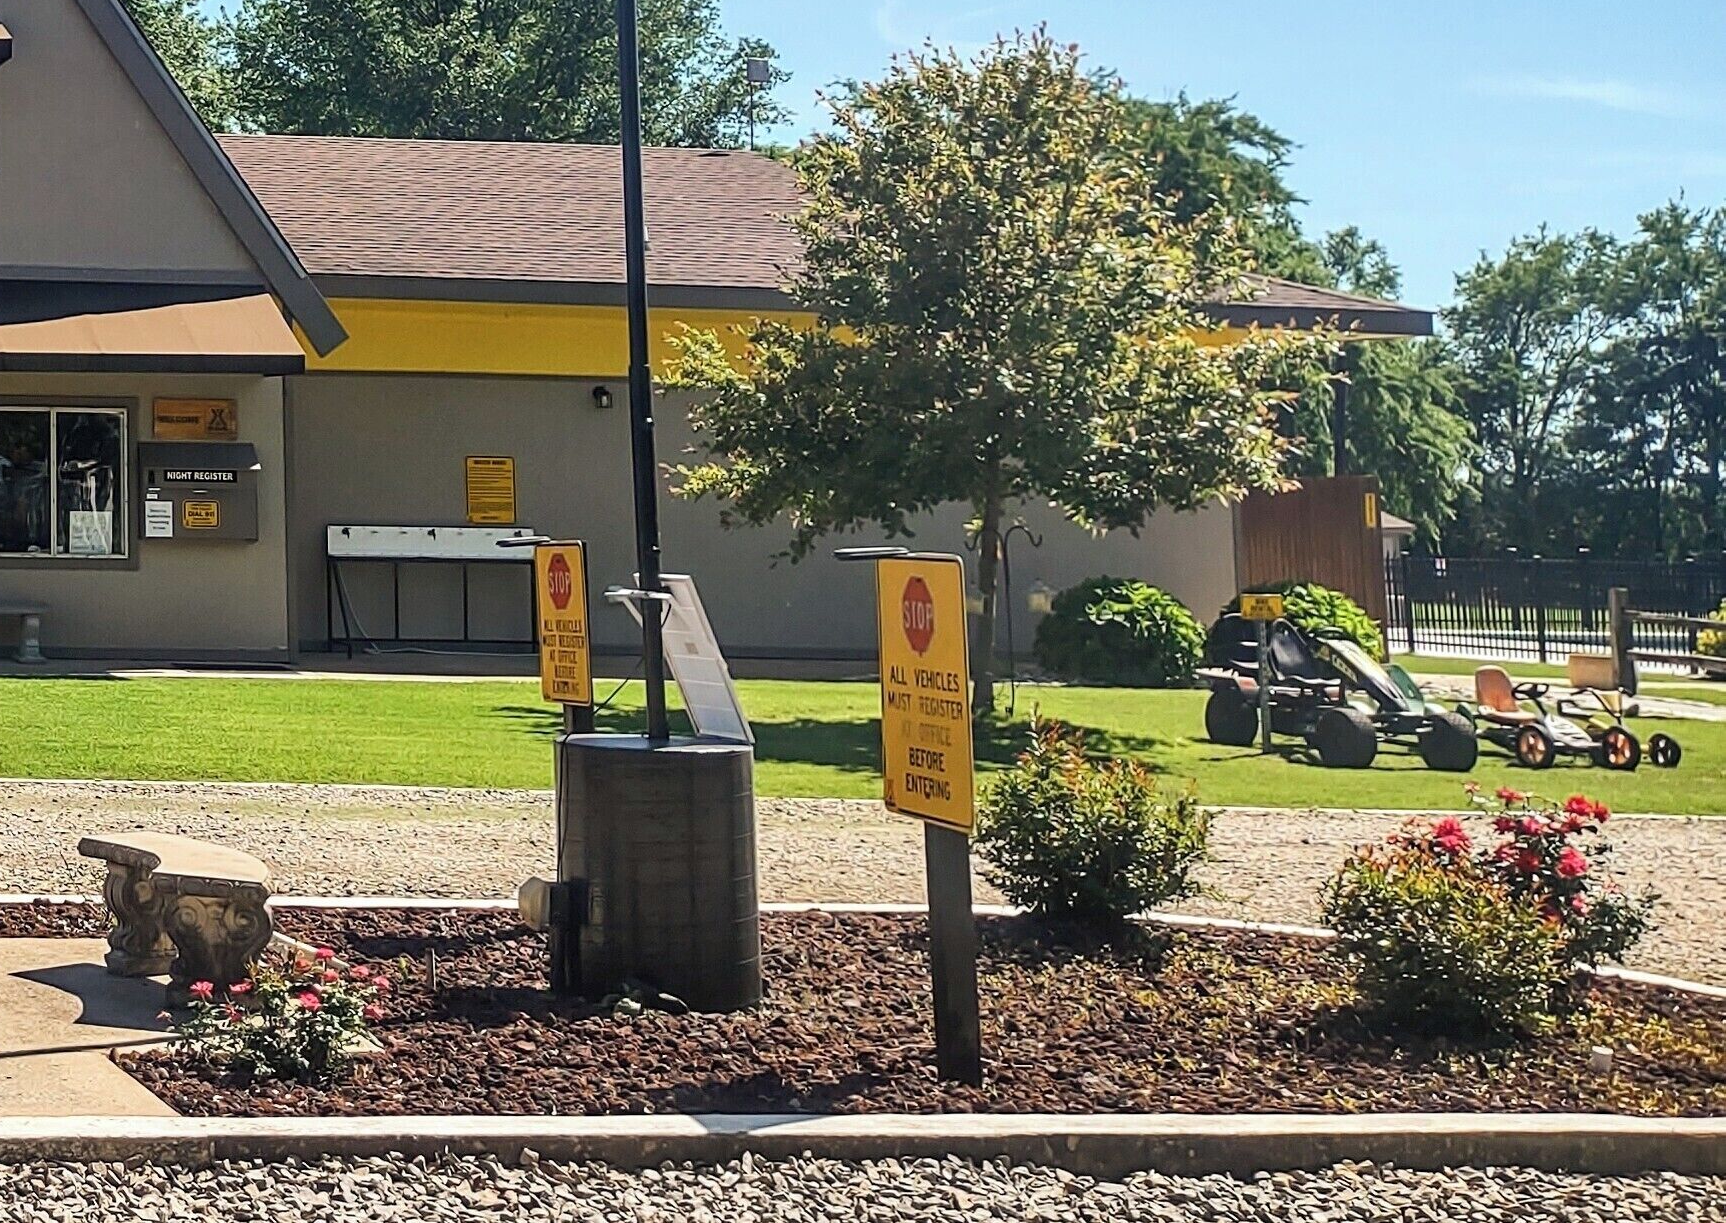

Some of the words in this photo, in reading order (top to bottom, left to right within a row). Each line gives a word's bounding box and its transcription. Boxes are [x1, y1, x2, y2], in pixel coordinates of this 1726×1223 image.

[166, 471, 192, 480] NIGHT
[194, 471, 233, 481] REGISTER
[548, 570, 571, 595] STOP
[544, 619, 554, 632] ALL
[555, 619, 583, 633] VEHICLES
[903, 599, 935, 628] STOP
[543, 634, 556, 647] MUST
[558, 649, 578, 664] OFFICE
[890, 665, 908, 686] ALL
[914, 668, 960, 693] VEHICLES
[887, 690, 912, 713] MUST
[919, 695, 964, 721] REGISTER
[919, 722, 953, 747] OFFICE
[908, 746, 946, 773] BEFORE
[905, 772, 951, 801] ENTERING
